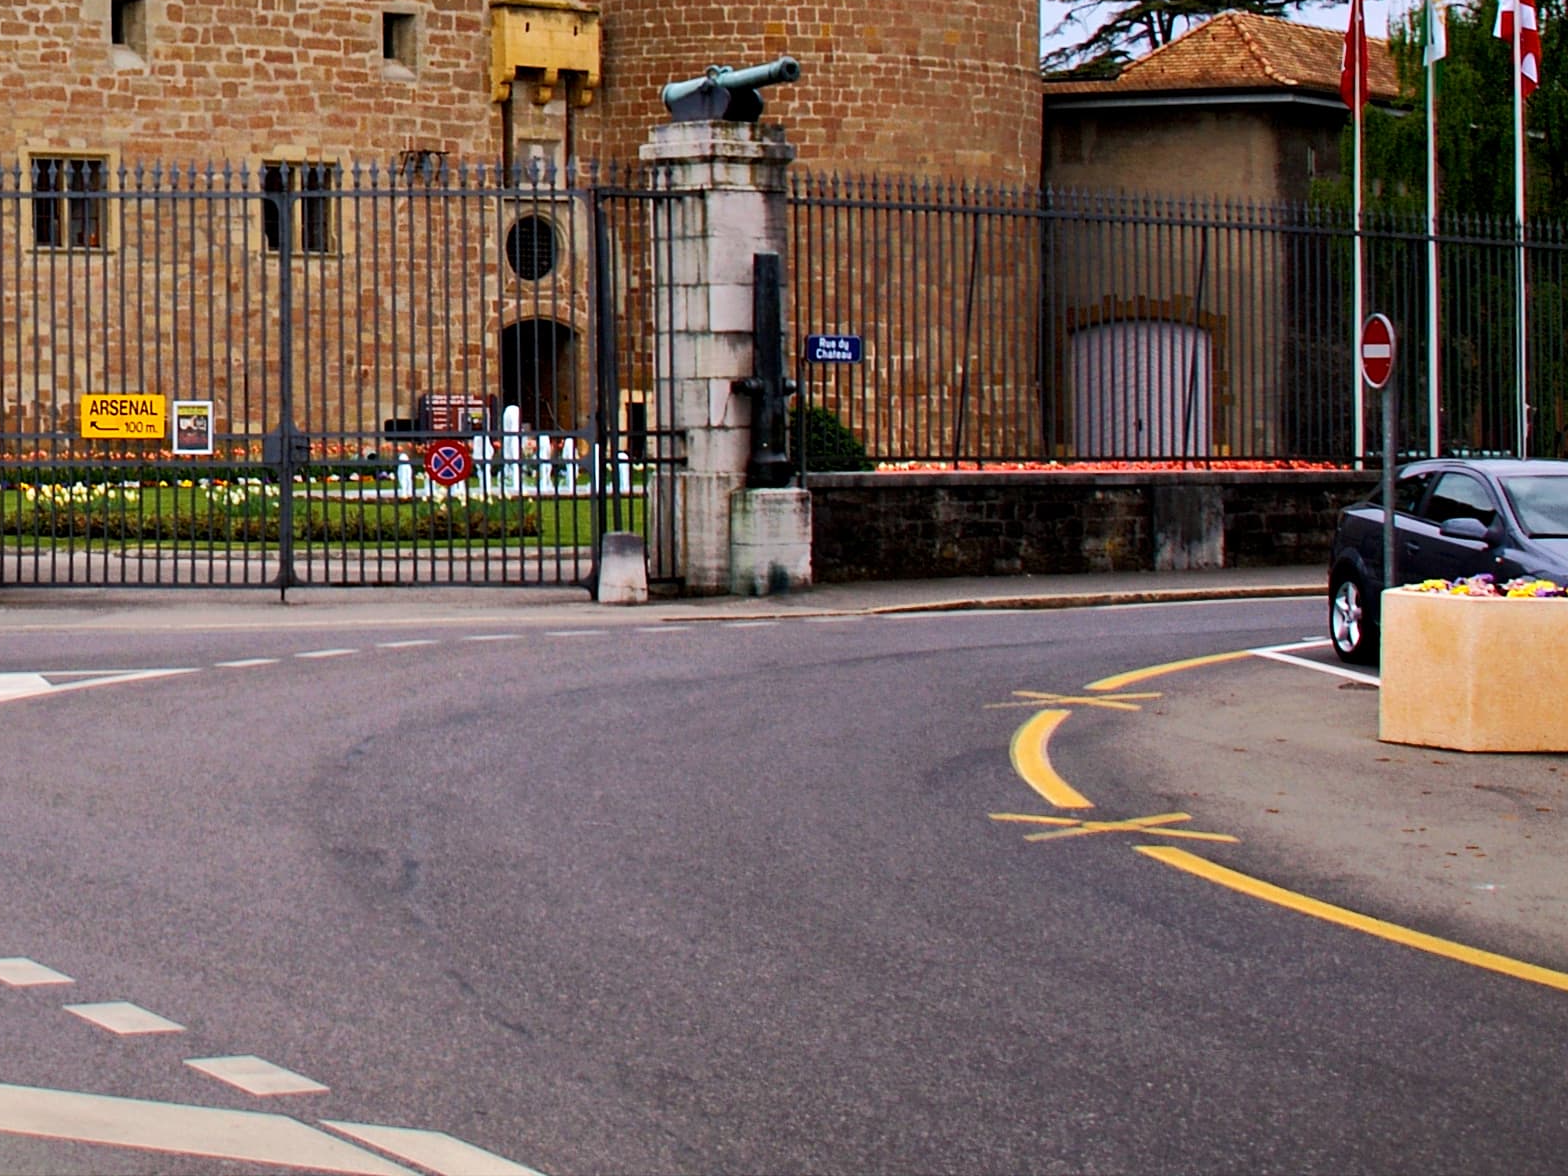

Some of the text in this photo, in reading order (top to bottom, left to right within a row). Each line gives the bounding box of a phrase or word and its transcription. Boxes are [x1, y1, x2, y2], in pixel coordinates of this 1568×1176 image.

[819, 337, 850, 351] Rue du
[89, 400, 158, 416] ARSENAL
[124, 421, 143, 433] 100
